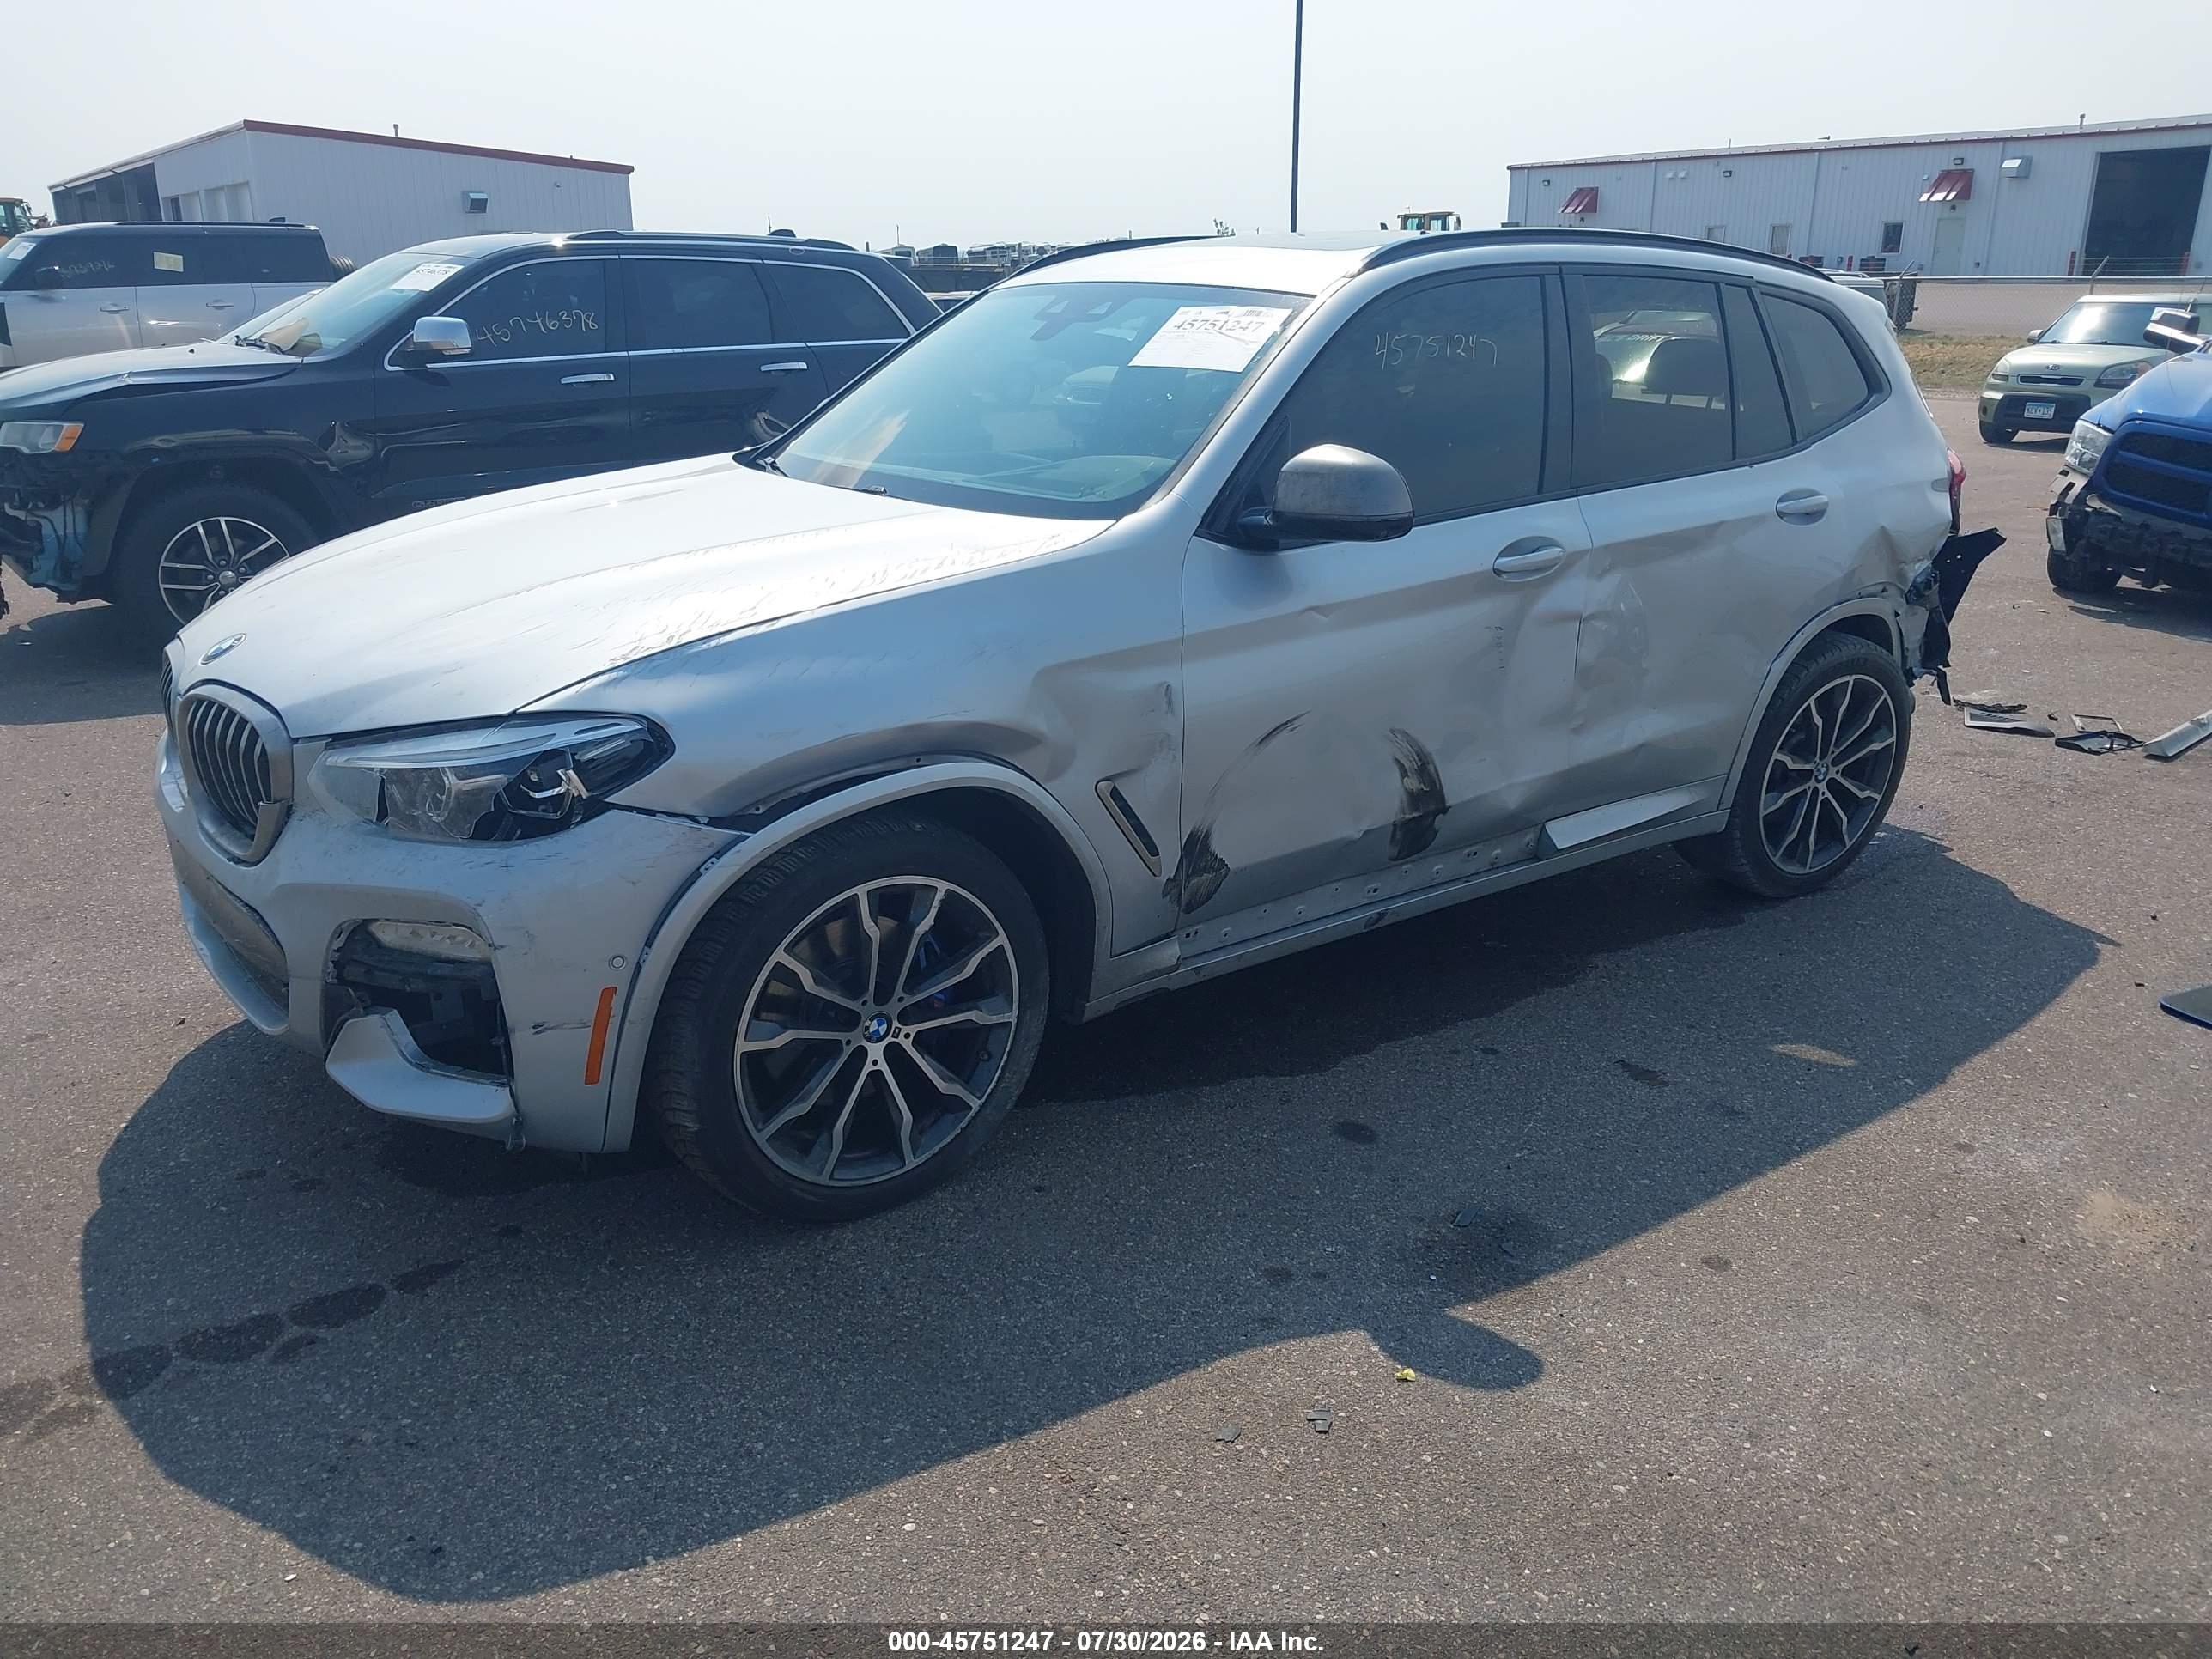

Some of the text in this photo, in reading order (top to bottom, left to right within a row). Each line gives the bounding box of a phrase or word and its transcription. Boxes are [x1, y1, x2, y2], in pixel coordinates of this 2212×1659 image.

[476, 309, 599, 348] 45746378
[1173, 319, 1265, 333] 45751247
[1375, 331, 1498, 370] 45751247
